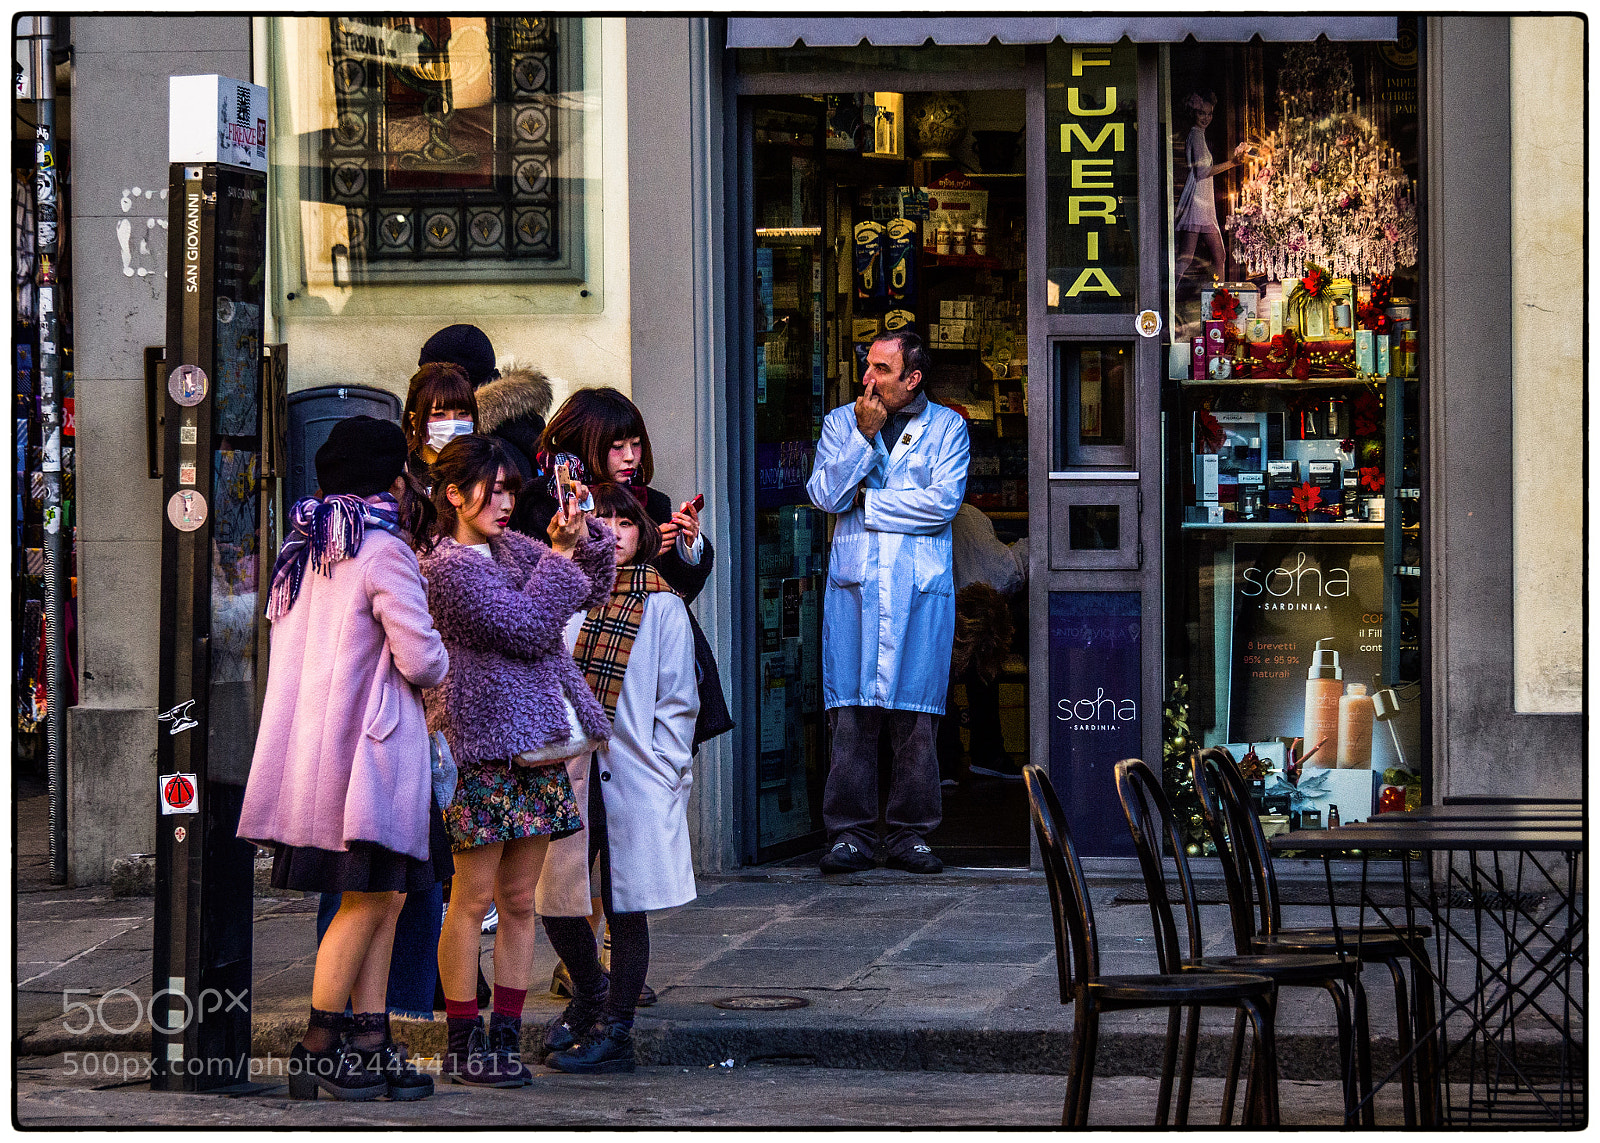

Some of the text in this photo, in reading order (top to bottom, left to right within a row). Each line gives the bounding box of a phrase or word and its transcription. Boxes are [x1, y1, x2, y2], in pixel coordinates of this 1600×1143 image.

[1387, 78, 1416, 87] IMPE
[228, 123, 256, 146] FIRENZE
[1060, 47, 1125, 297] FUMERIA
[186, 193, 199, 293] SAN GIOVANNI
[1241, 551, 1350, 597] soha
[1264, 602, 1322, 611] SARDINIA
[1359, 629, 1365, 638] il
[1247, 641, 1296, 650] 8 brevetti
[1359, 644, 1383, 652] cont
[1243, 656, 1261, 664] 95%
[1252, 670, 1290, 678] naturali
[1056, 687, 1136, 720] soha
